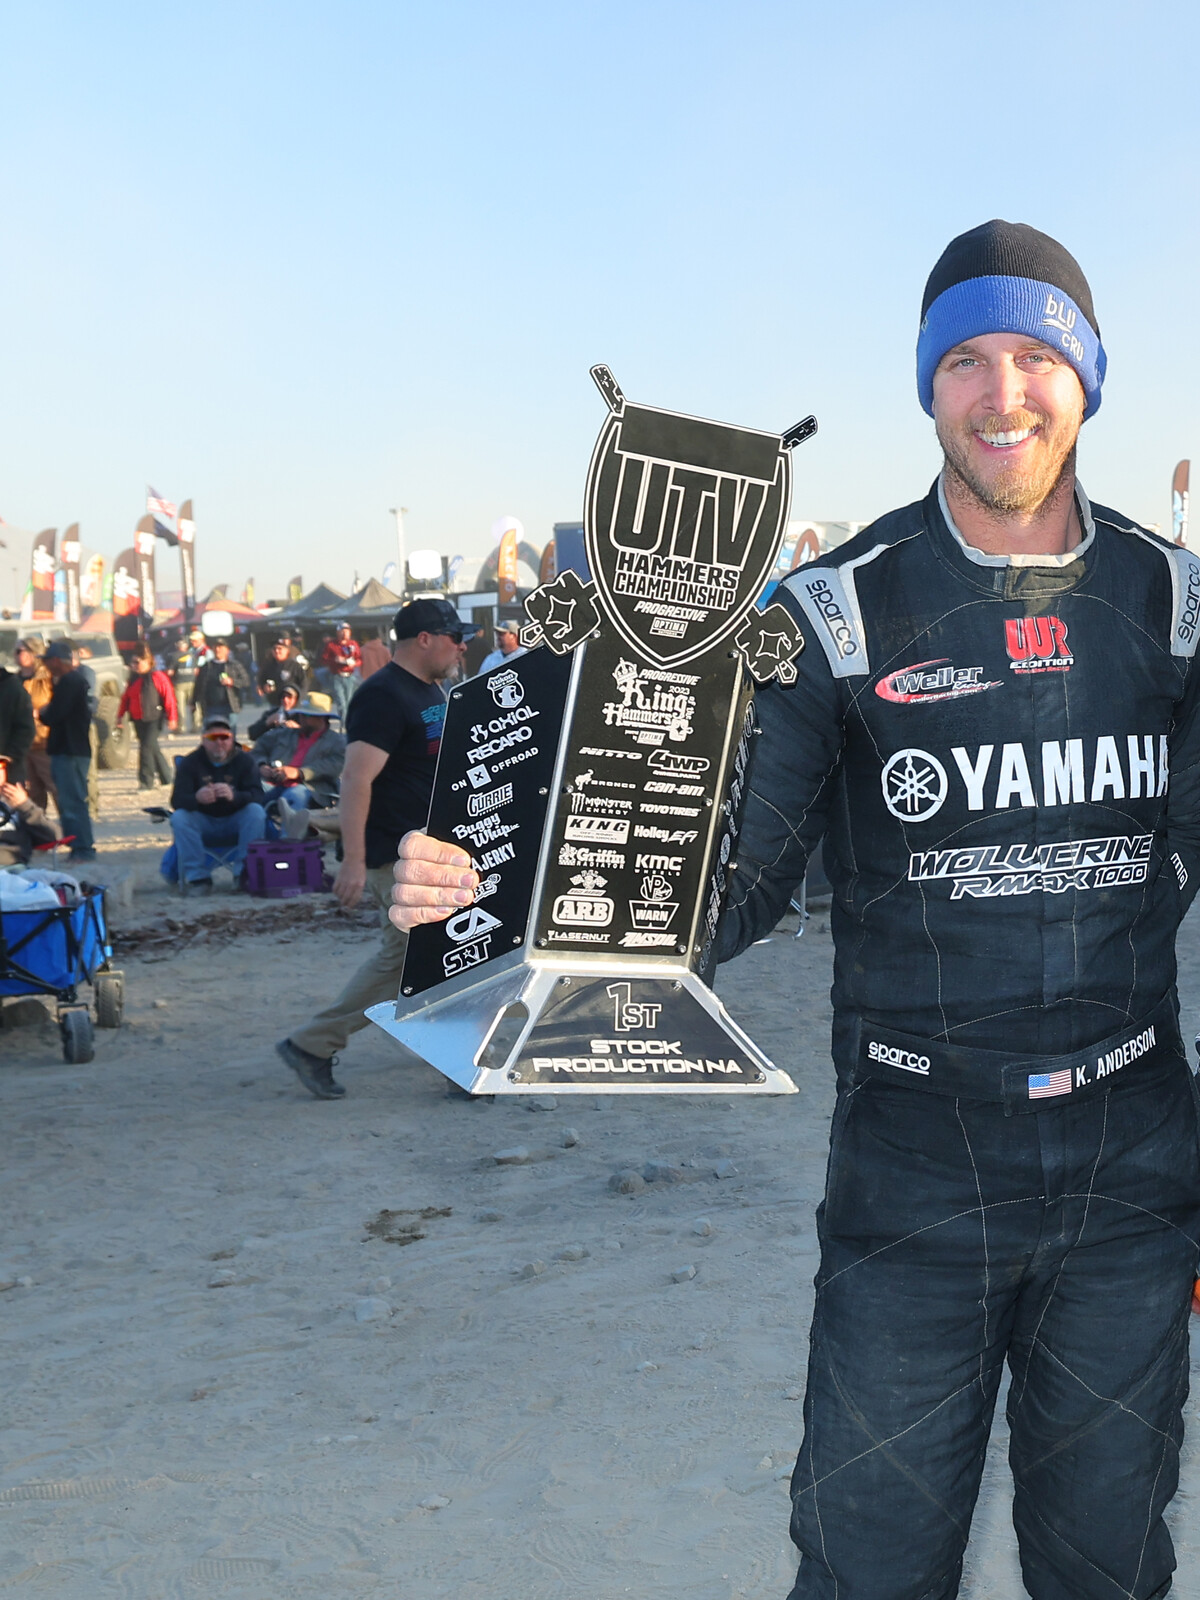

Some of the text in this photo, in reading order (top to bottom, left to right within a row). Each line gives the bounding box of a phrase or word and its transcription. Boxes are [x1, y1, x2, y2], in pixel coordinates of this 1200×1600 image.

[609, 454, 770, 571] UTV
[616, 550, 741, 591] HAMMERS
[613, 571, 736, 611] CHAMPIONSHIP
[633, 601, 709, 622] PROGRESSIVE
[807, 580, 857, 657] sparco
[652, 618, 686, 633] OPTIMA
[1009, 657, 1075, 669] EDITION
[639, 669, 701, 686] PROGRESSIVE
[896, 667, 983, 694] Weller
[618, 679, 689, 719] King
[668, 685, 690, 695] 2023
[602, 702, 673, 727] Hammers
[466, 726, 533, 764] RECARO
[579, 747, 643, 760] NITTO
[451, 779, 467, 791] ON
[491, 747, 539, 773] OFFROAD
[647, 749, 711, 773] 4WP
[591, 780, 636, 789] BRONCO
[643, 781, 705, 797] can-am
[467, 782, 514, 817] CURRIE
[585, 797, 633, 810] MONSTER
[586, 807, 629, 816] ENERGY
[639, 803, 701, 818] TOYO TIRES
[451, 812, 501, 840] Buggy
[569, 819, 627, 832] KING
[633, 825, 670, 843] Holley
[469, 823, 511, 848] Whip
[577, 848, 626, 865] Griffin
[577, 860, 625, 869] RADIATOR
[635, 853, 683, 871] KMC
[908, 834, 1154, 881] WOLVERINE
[950, 868, 1092, 900] RMAX
[1093, 863, 1149, 889] 1000
[558, 900, 609, 921] ARB
[636, 909, 669, 922] WARN
[554, 931, 611, 942] LASERNUT
[618, 932, 678, 947] AMSOIL
[606, 981, 662, 1032] 1ST
[590, 1039, 683, 1055] STOCK
[1075, 1067, 1091, 1088] K.
[1096, 1025, 1156, 1080] ANDERSON
[532, 1057, 743, 1074] PRODUCTION NA
[867, 1041, 931, 1075] sparco
